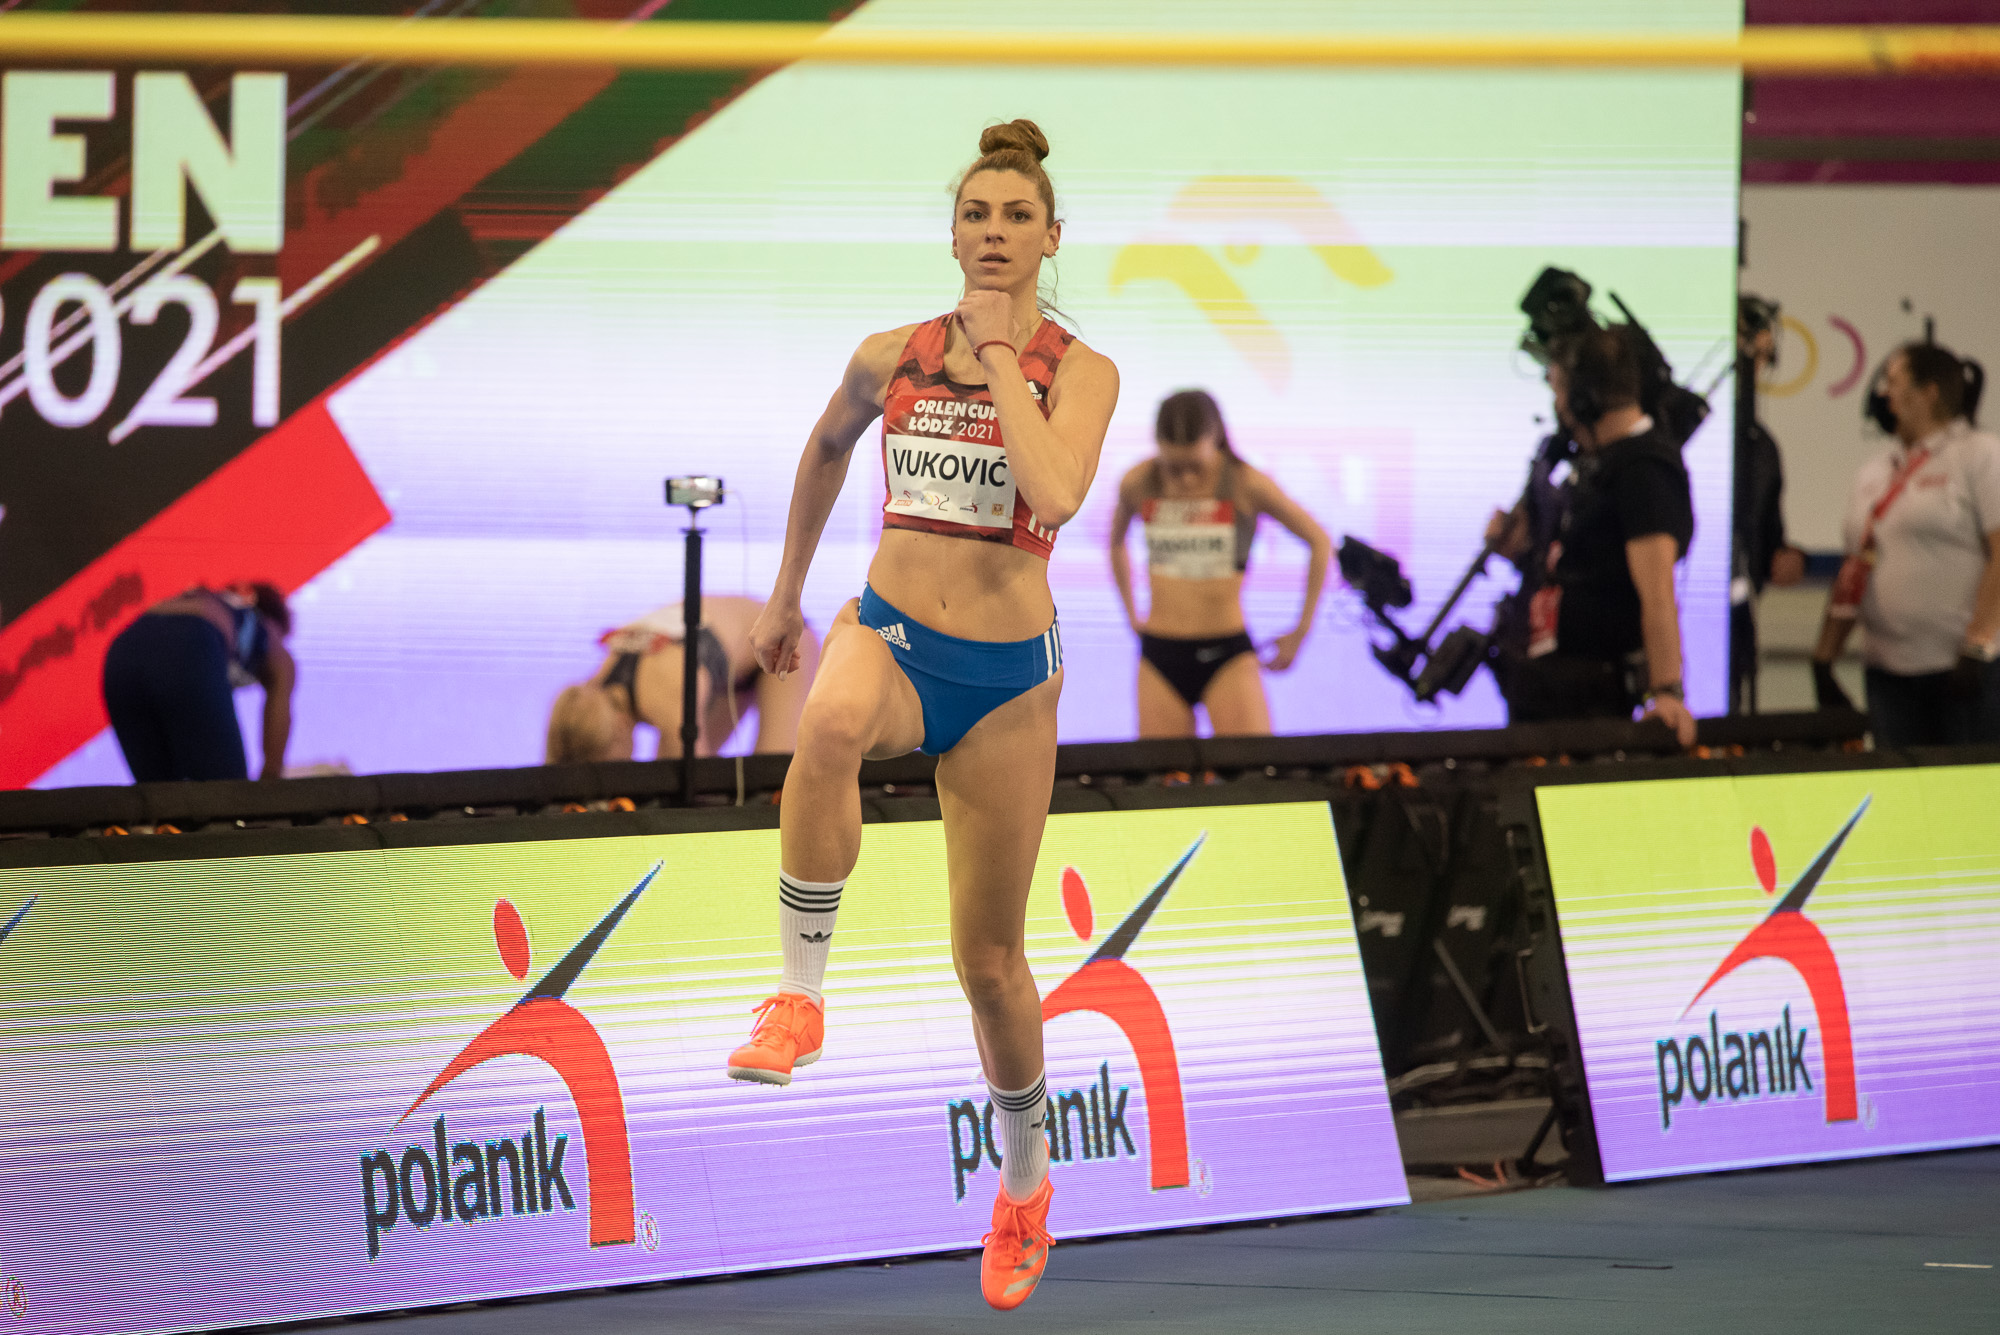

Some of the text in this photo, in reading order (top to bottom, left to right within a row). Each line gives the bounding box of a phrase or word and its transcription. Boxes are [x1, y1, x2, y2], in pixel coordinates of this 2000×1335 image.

[0, 272, 281, 428] 021
[913, 399, 967, 417] ORLEN
[892, 448, 1008, 487] VUKOVIĆ
[908, 413, 994, 440] ŁÓDŹ 2021
[948, 1059, 1136, 1204] ponik
[1656, 1001, 1814, 1132] polanik
[360, 1104, 577, 1263] polanik
